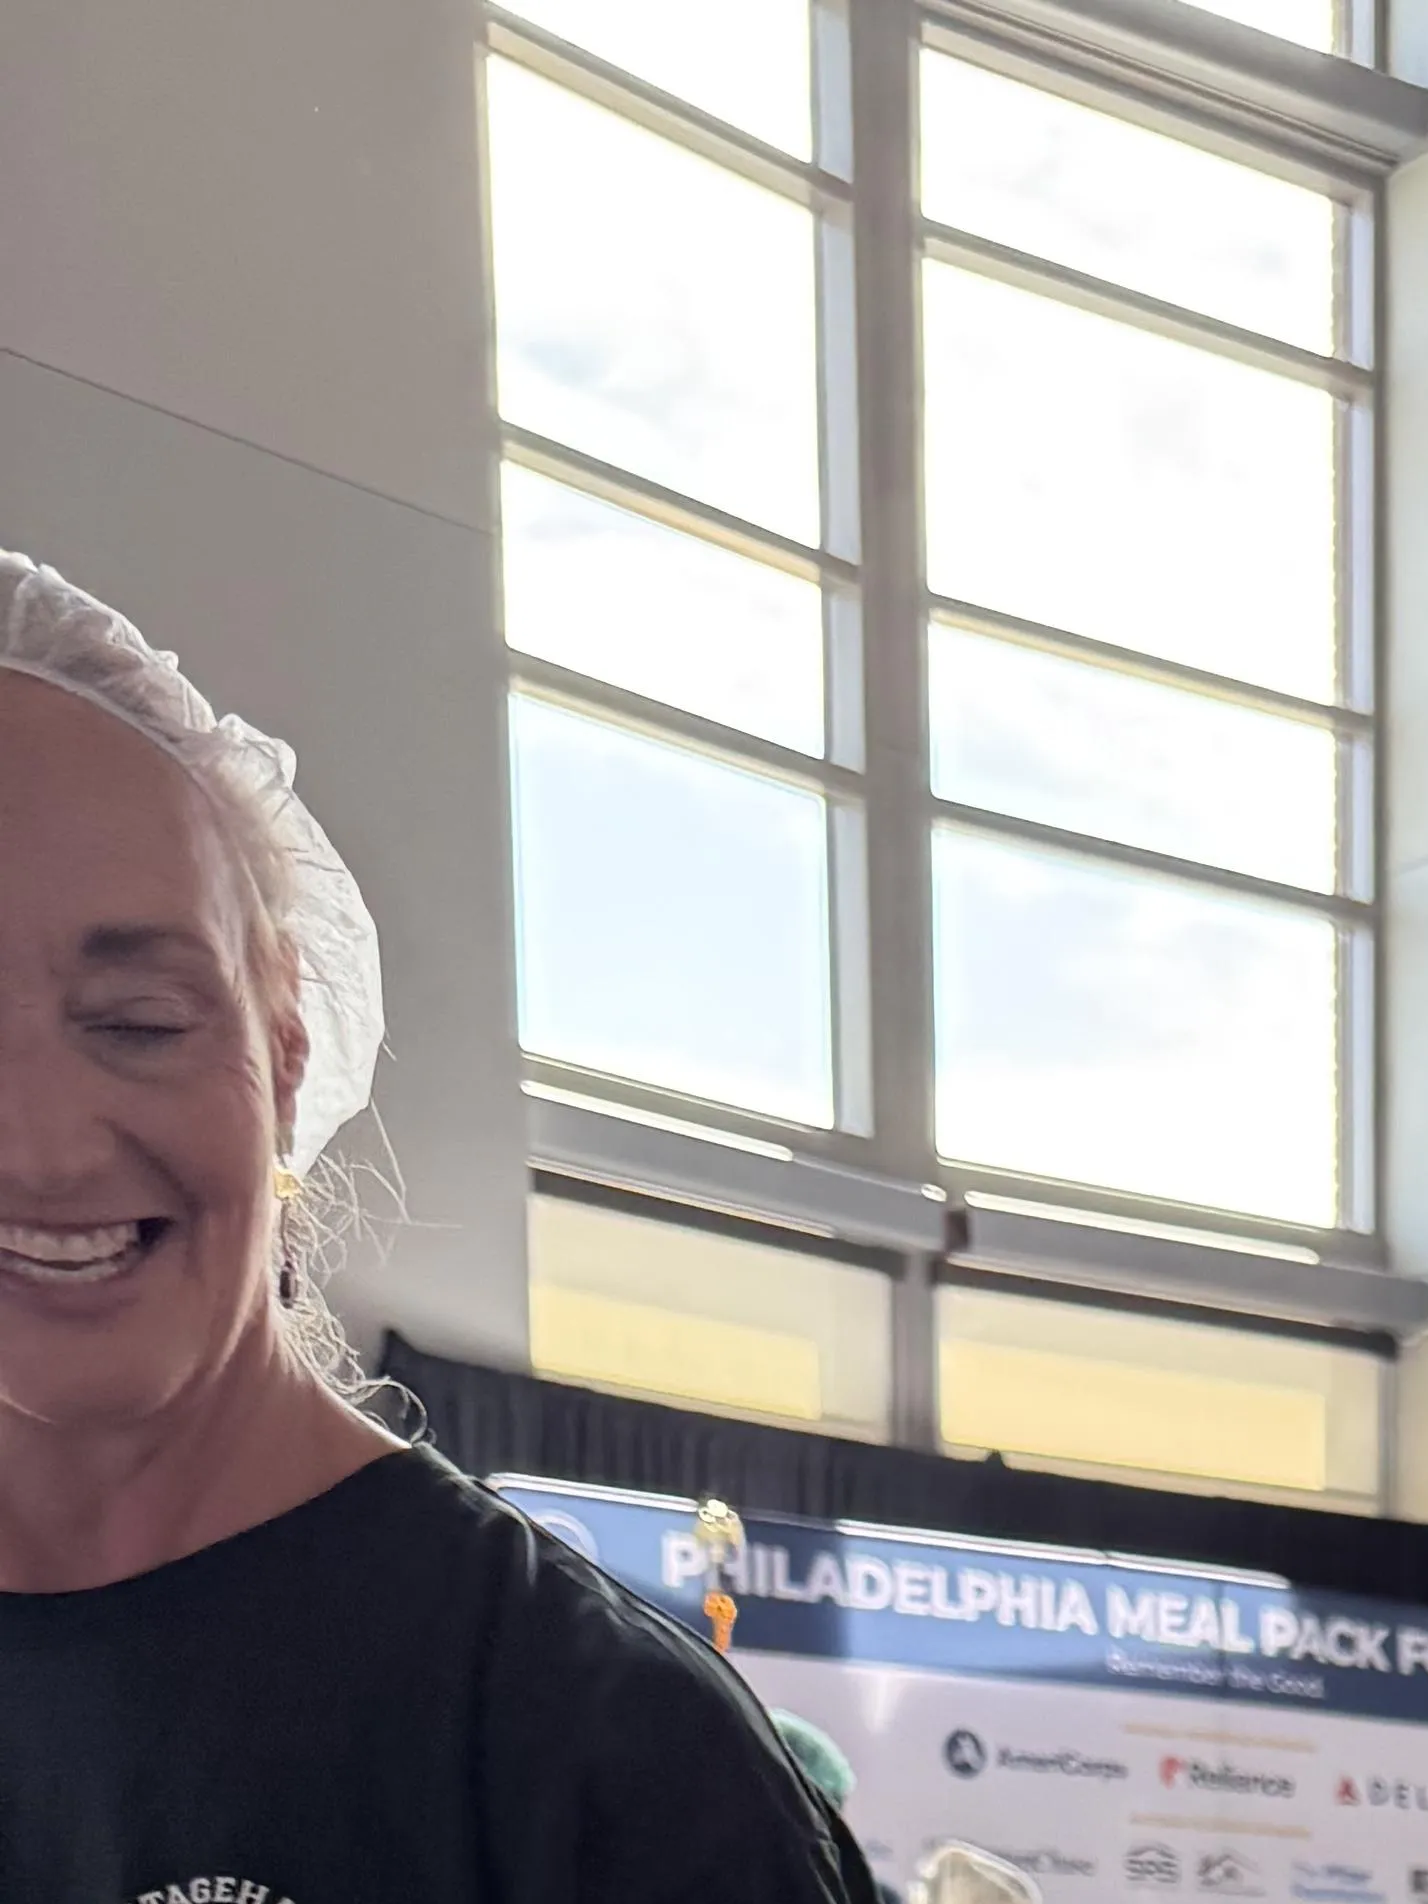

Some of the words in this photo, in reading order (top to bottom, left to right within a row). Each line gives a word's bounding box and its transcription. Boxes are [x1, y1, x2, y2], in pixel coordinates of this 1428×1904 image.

[661, 1530, 1099, 1636] PHILADELPHIA
[1104, 1583, 1256, 1653] MEAL
[1258, 1604, 1392, 1673] PACK
